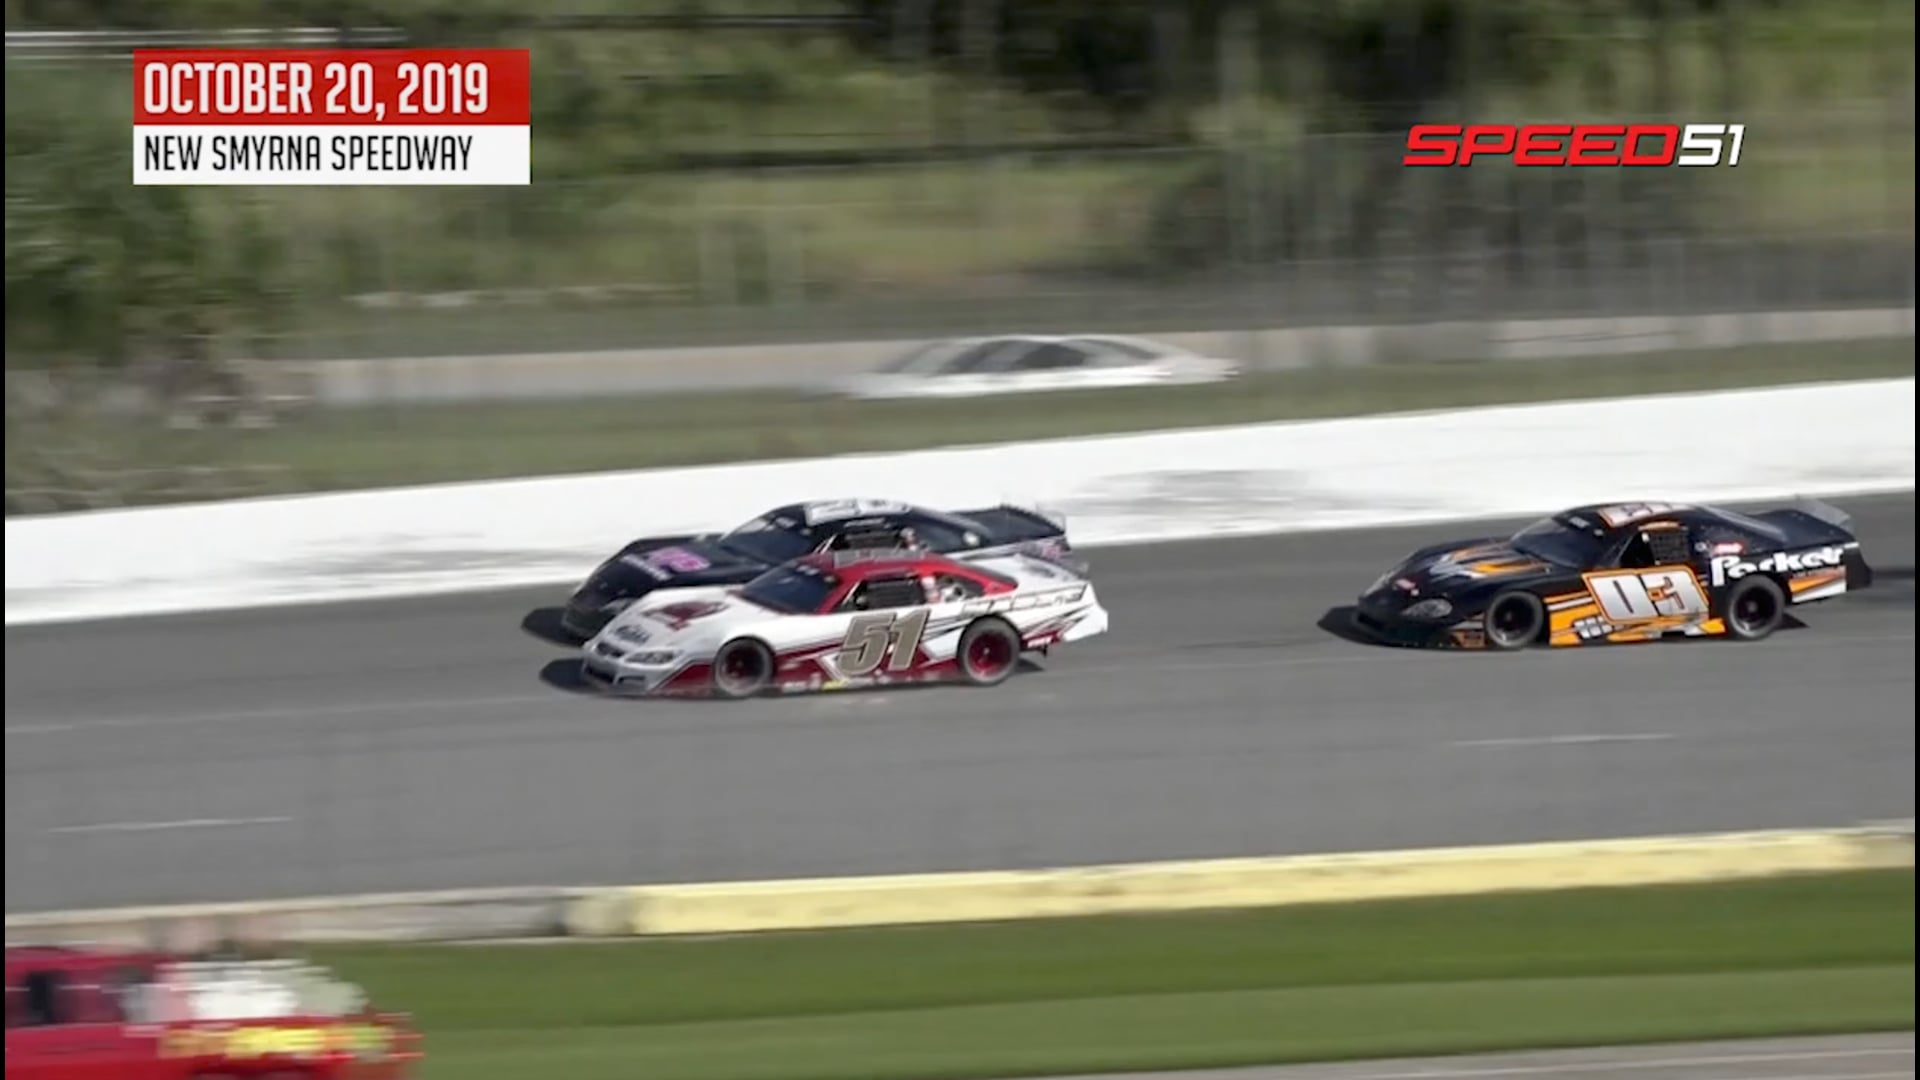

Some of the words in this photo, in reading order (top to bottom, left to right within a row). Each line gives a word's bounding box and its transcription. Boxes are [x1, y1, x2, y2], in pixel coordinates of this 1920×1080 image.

[1711, 546, 1844, 587] Parker
[1588, 570, 1710, 621] 03
[837, 608, 931, 677] 51
